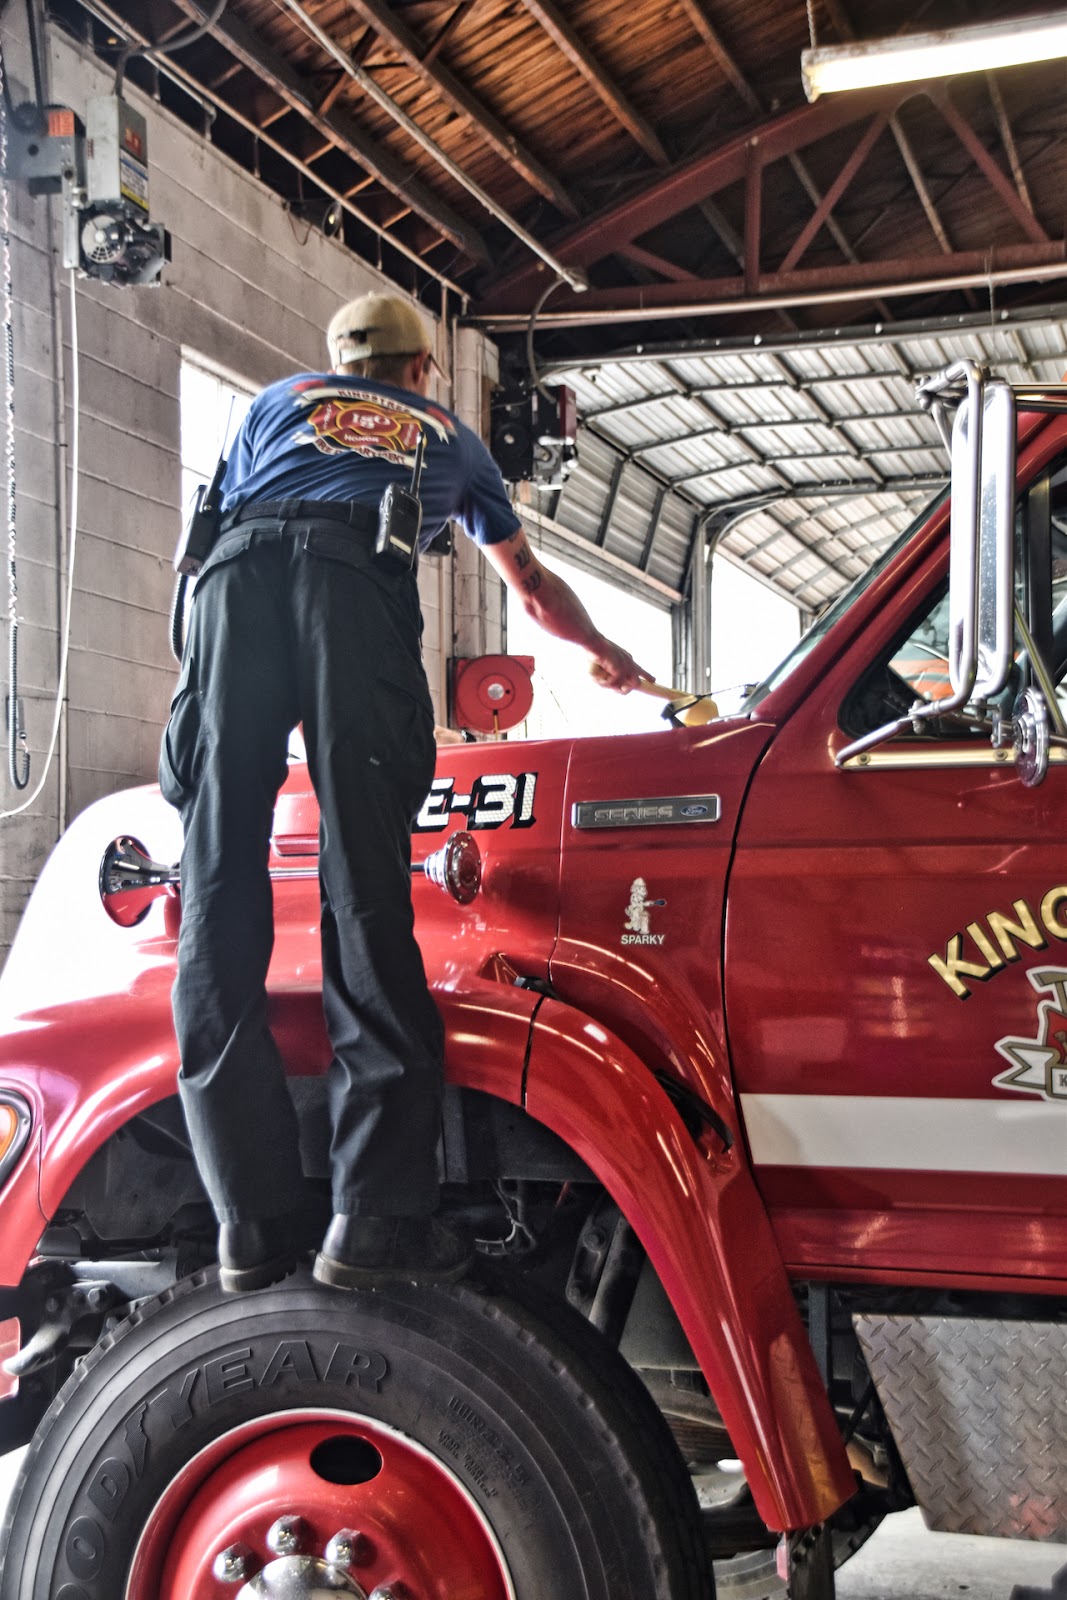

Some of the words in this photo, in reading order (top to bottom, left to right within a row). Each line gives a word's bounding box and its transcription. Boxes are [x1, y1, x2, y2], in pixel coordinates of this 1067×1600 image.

[343, 433, 380, 443] HONOR
[413, 772, 538, 831] E-31
[594, 805, 673, 822] SERIES
[683, 804, 707, 816] Ford
[620, 934, 665, 945] SPARKY
